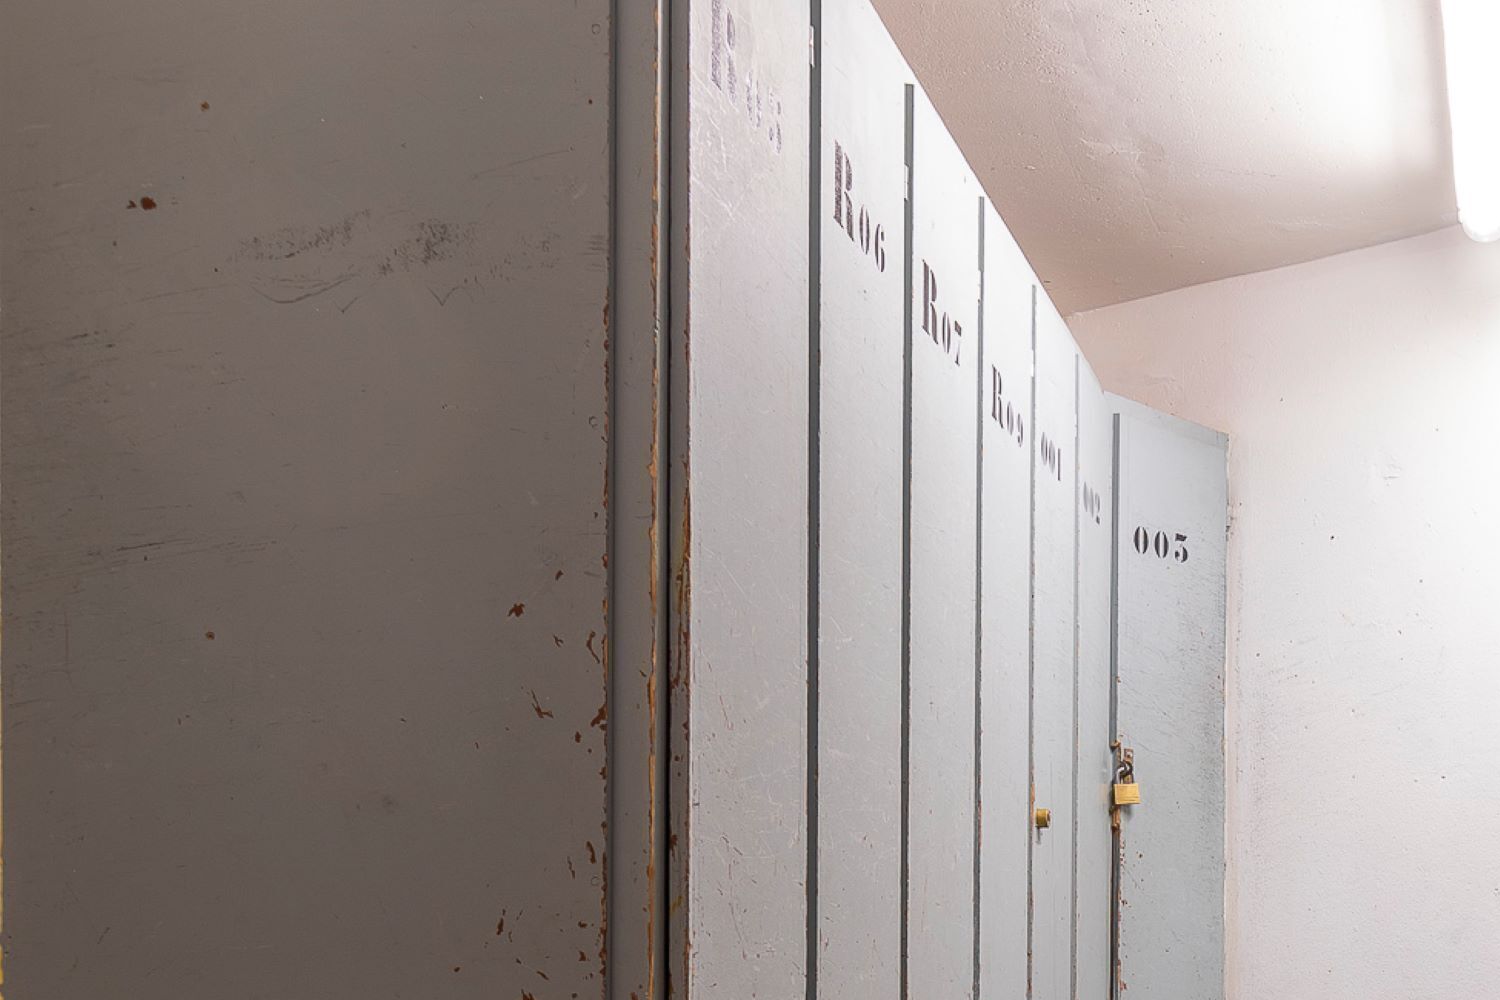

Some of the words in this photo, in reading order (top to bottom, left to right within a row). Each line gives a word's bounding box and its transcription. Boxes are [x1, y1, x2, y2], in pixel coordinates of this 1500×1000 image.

[833, 138, 885, 273] R06
[922, 258, 962, 367] R07
[992, 364, 1024, 448] R09
[1041, 431, 1061, 482] 001
